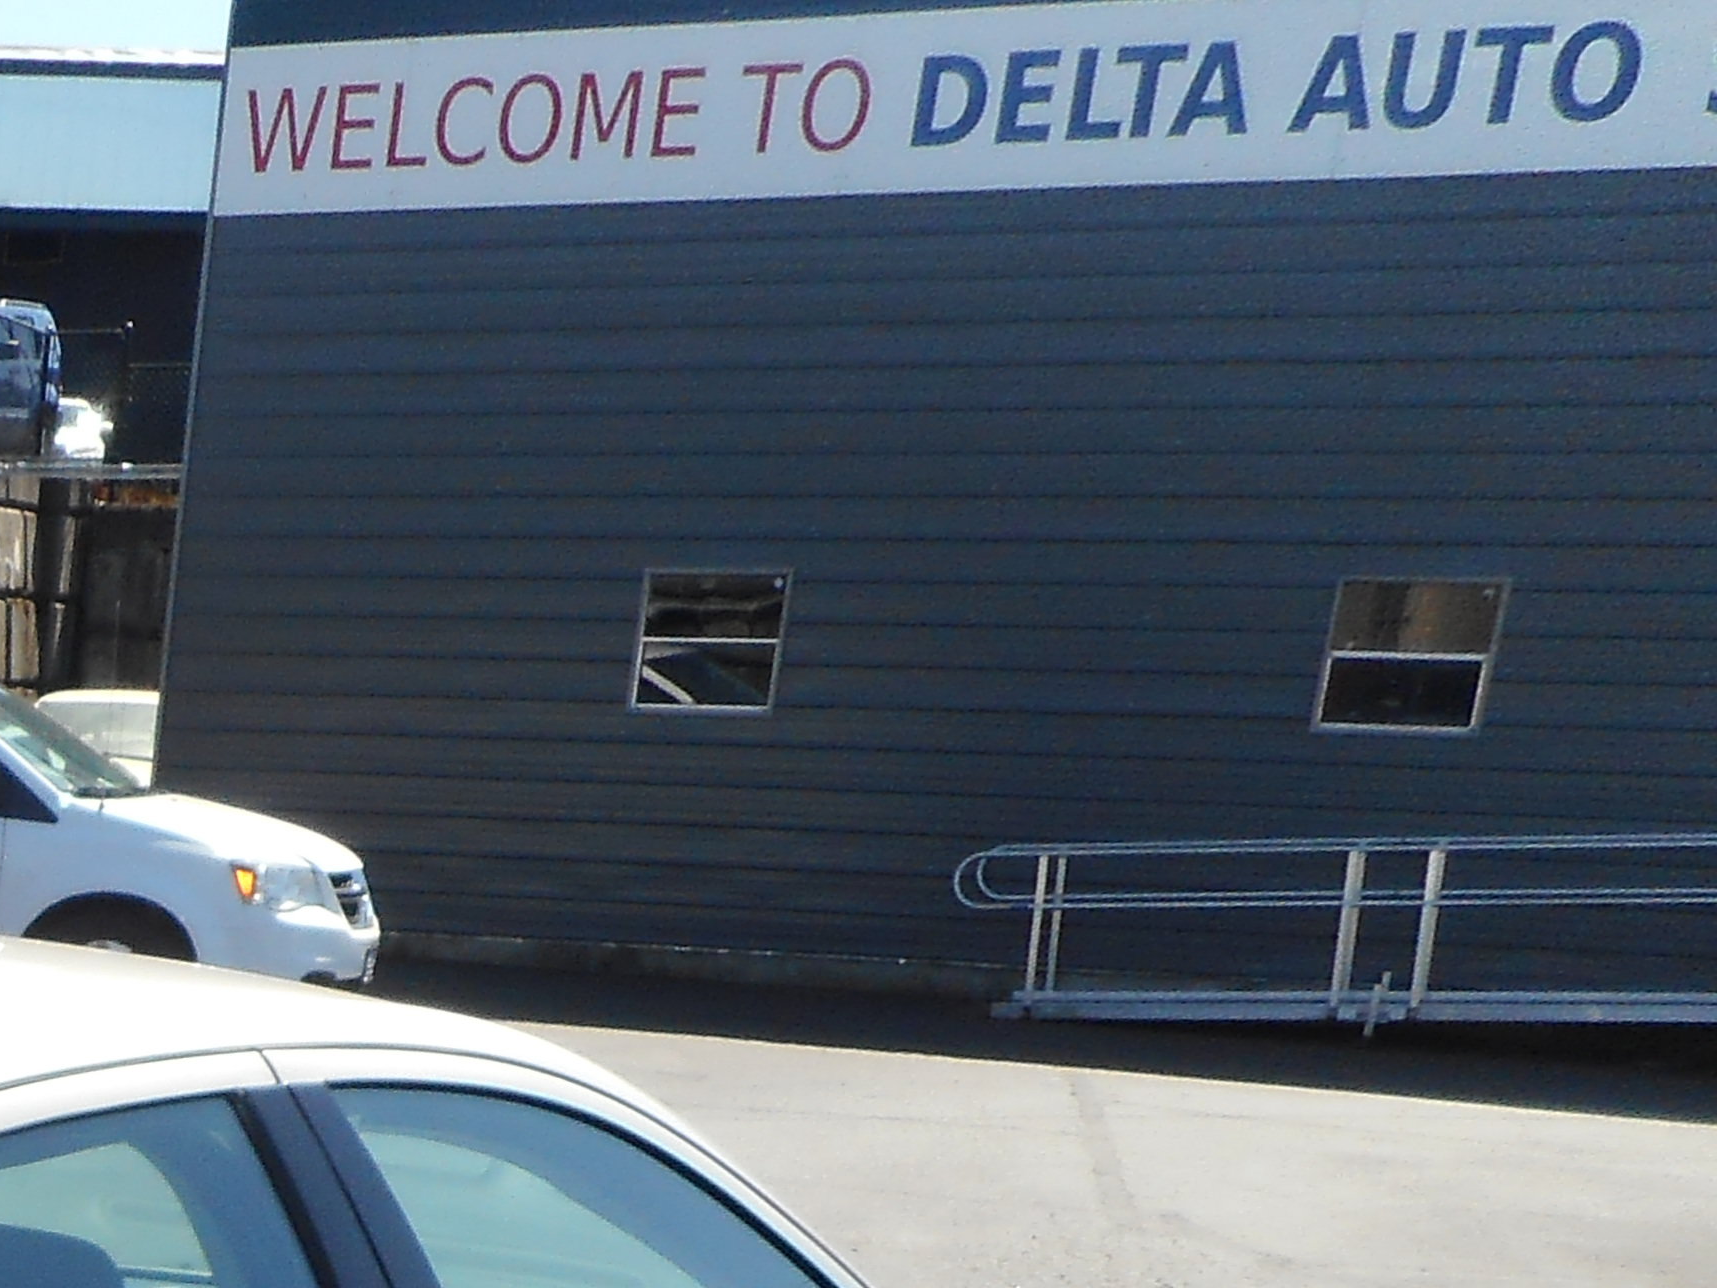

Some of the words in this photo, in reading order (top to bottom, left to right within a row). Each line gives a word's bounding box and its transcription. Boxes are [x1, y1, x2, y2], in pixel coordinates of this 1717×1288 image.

[246, 66, 706, 174] WELCOME
[742, 57, 872, 154] TO
[909, 39, 1248, 148] DELTA
[1289, 19, 1643, 132] AUTO
